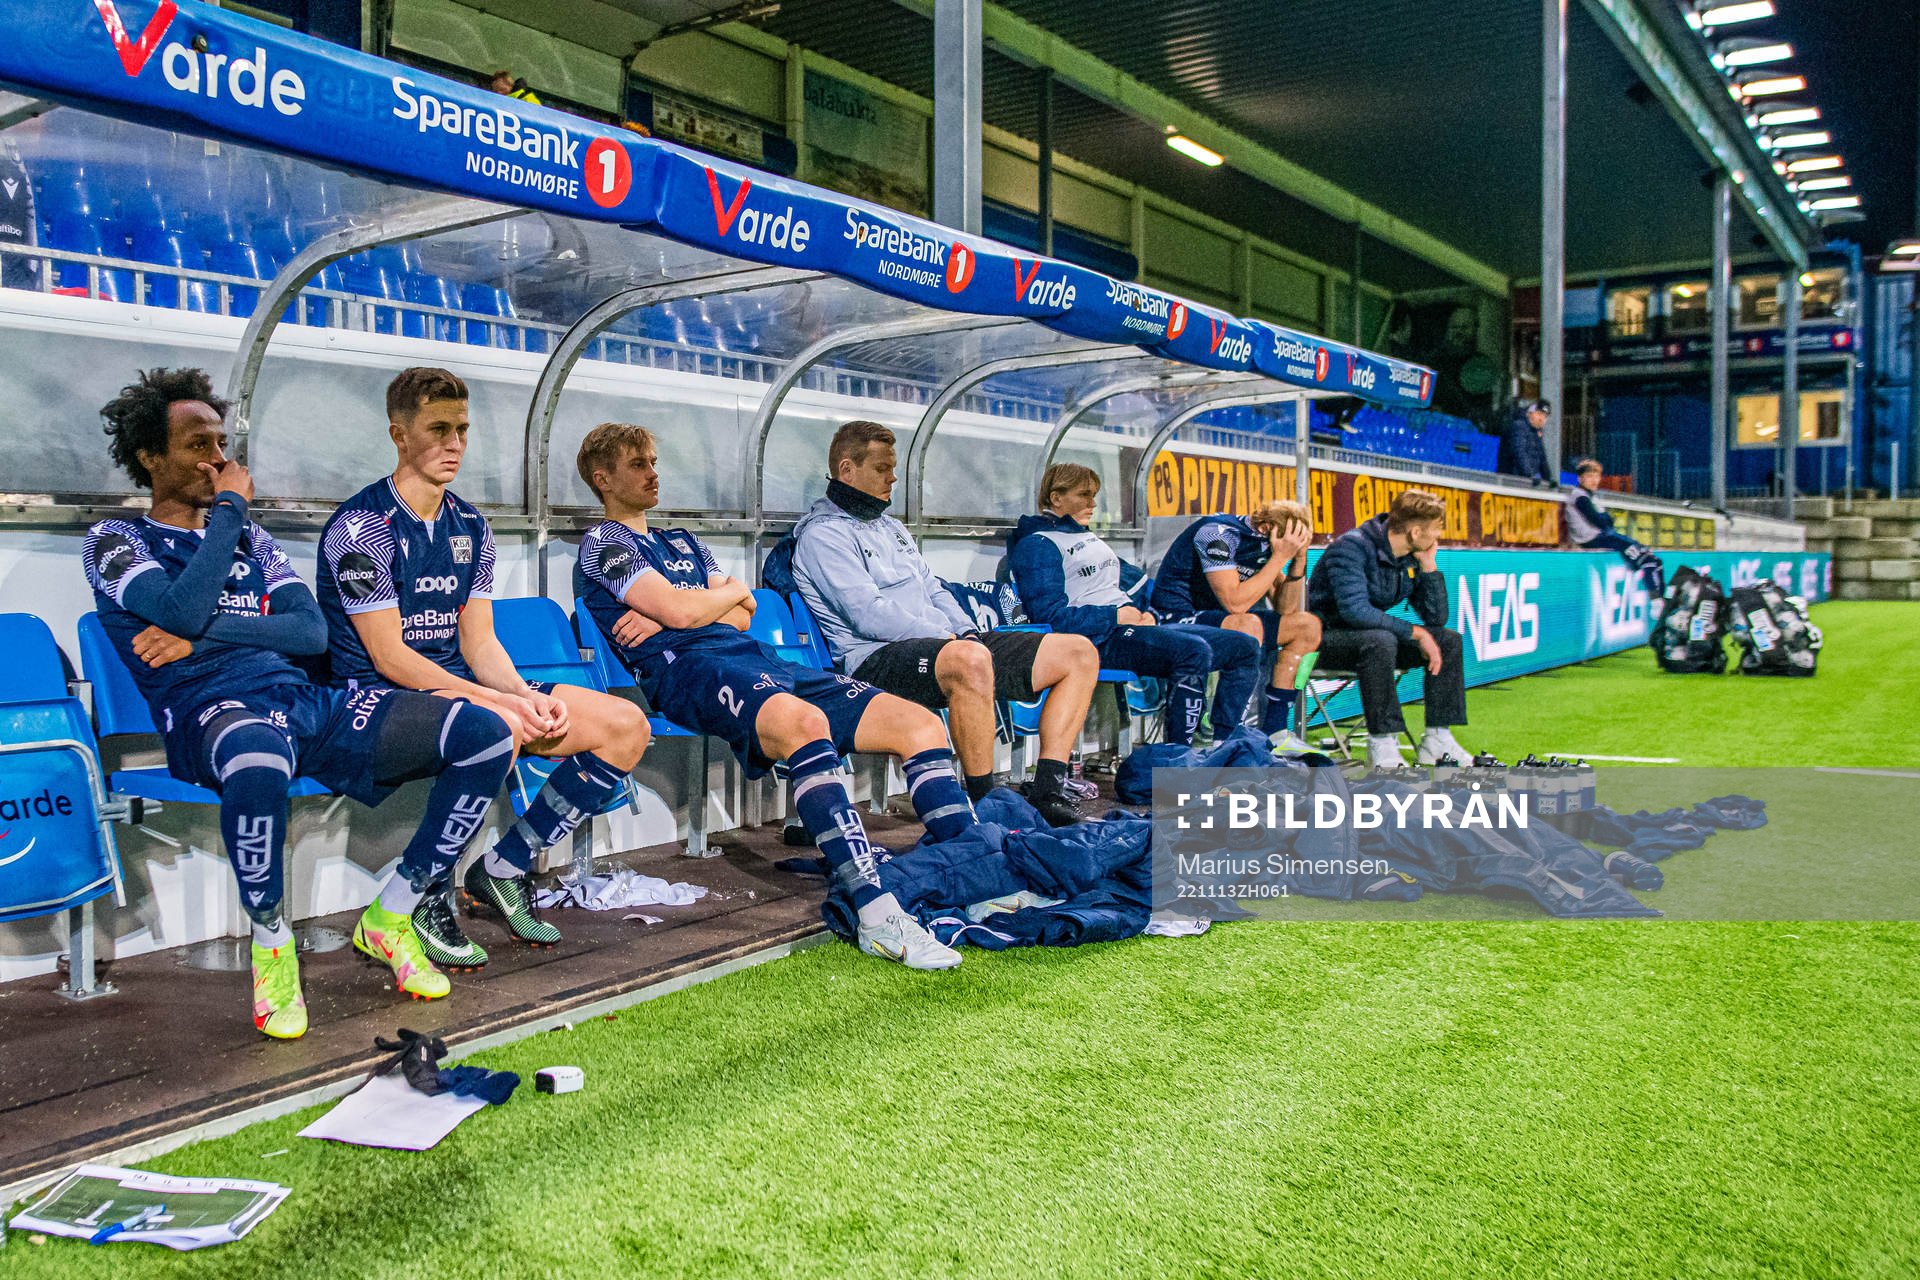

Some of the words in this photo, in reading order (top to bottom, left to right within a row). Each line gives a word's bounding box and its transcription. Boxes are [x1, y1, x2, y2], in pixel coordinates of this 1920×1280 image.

[95, 0, 306, 116] Varde
[392, 76, 582, 169] SpareBank
[465, 150, 580, 200] NORDMØRE
[704, 165, 811, 253] Varde
[843, 207, 945, 266] SpareBank
[878, 259, 942, 289] NORDMØRE
[1013, 257, 1076, 310] Varde
[1122, 315, 1167, 336] NORDMØRE
[1210, 318, 1252, 363] Varde
[1273, 335, 1317, 364] SpareBank
[1345, 351, 1376, 390] Varde
[99, 545, 132, 574] altibox
[339, 569, 376, 582] altibox
[602, 552, 630, 574] altibox
[1458, 572, 1540, 662] NEAS
[717, 685, 745, 718] 2
[1185, 698, 1202, 734] NEAS
[0, 789, 73, 823] arde
[436, 794, 493, 856] NEAS
[236, 815, 274, 884] NEAS
